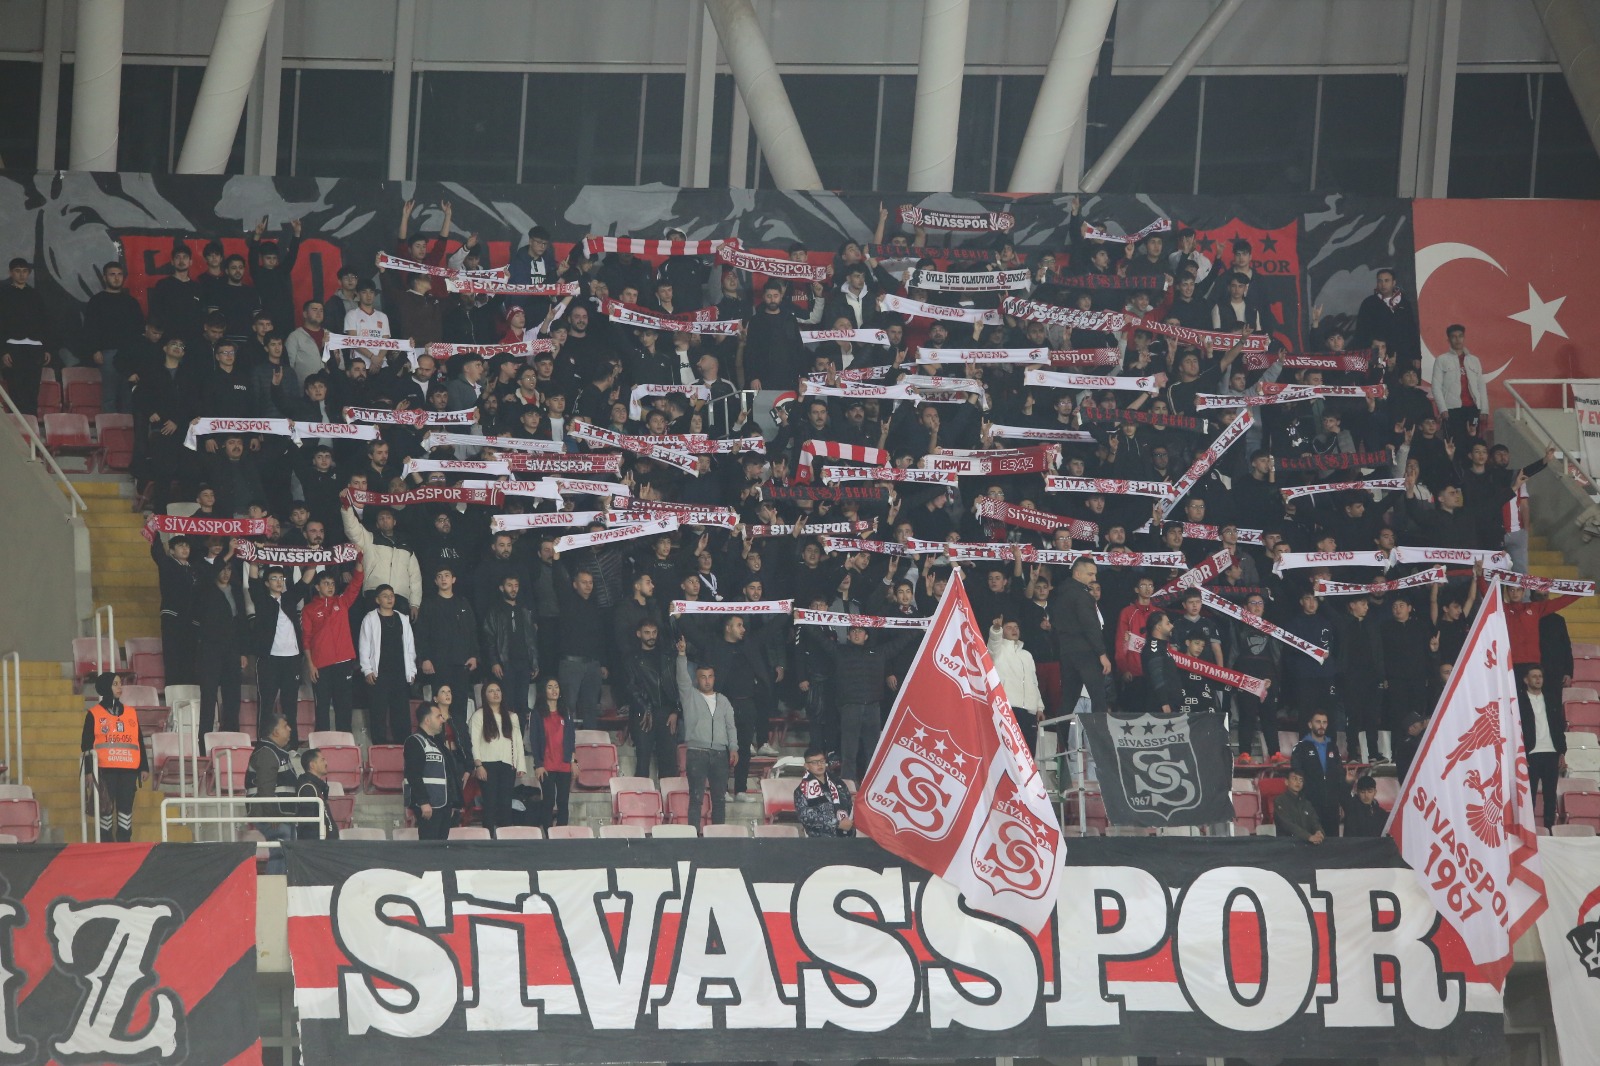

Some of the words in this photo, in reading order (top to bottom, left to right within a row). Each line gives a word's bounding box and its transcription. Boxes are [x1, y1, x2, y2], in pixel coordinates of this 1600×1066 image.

[924, 214, 988, 229] SİVASSPOR
[926, 272, 943, 283] ÖYLE
[961, 274, 994, 284] OLMUYOR
[1003, 299, 1031, 315] 1967
[1052, 353, 1095, 363] asspor
[1068, 376, 1116, 386] LEGEND
[308, 423, 358, 435] LEGEND
[525, 459, 593, 471] SİVASSPOR
[934, 459, 971, 472] KIRMIZI
[1000, 457, 1034, 471] BEYAZ
[164, 516, 243, 534] SİVASSPOR
[527, 513, 574, 525] LEGEND
[257, 550, 332, 563] SİVASSPOR
[1424, 550, 1471, 560] LEGEND
[938, 653, 961, 671] 1967
[1192, 660, 1241, 684] OTYAKMAZ
[1117, 733, 1186, 748] SİVASSPOR
[898, 732, 968, 785] SİVASSPOR
[871, 792, 896, 808] 1967
[1130, 796, 1150, 806] 1967
[996, 799, 1052, 851] SİVASOR
[974, 857, 993, 874] 1967
[1423, 842, 1482, 923] 1967
